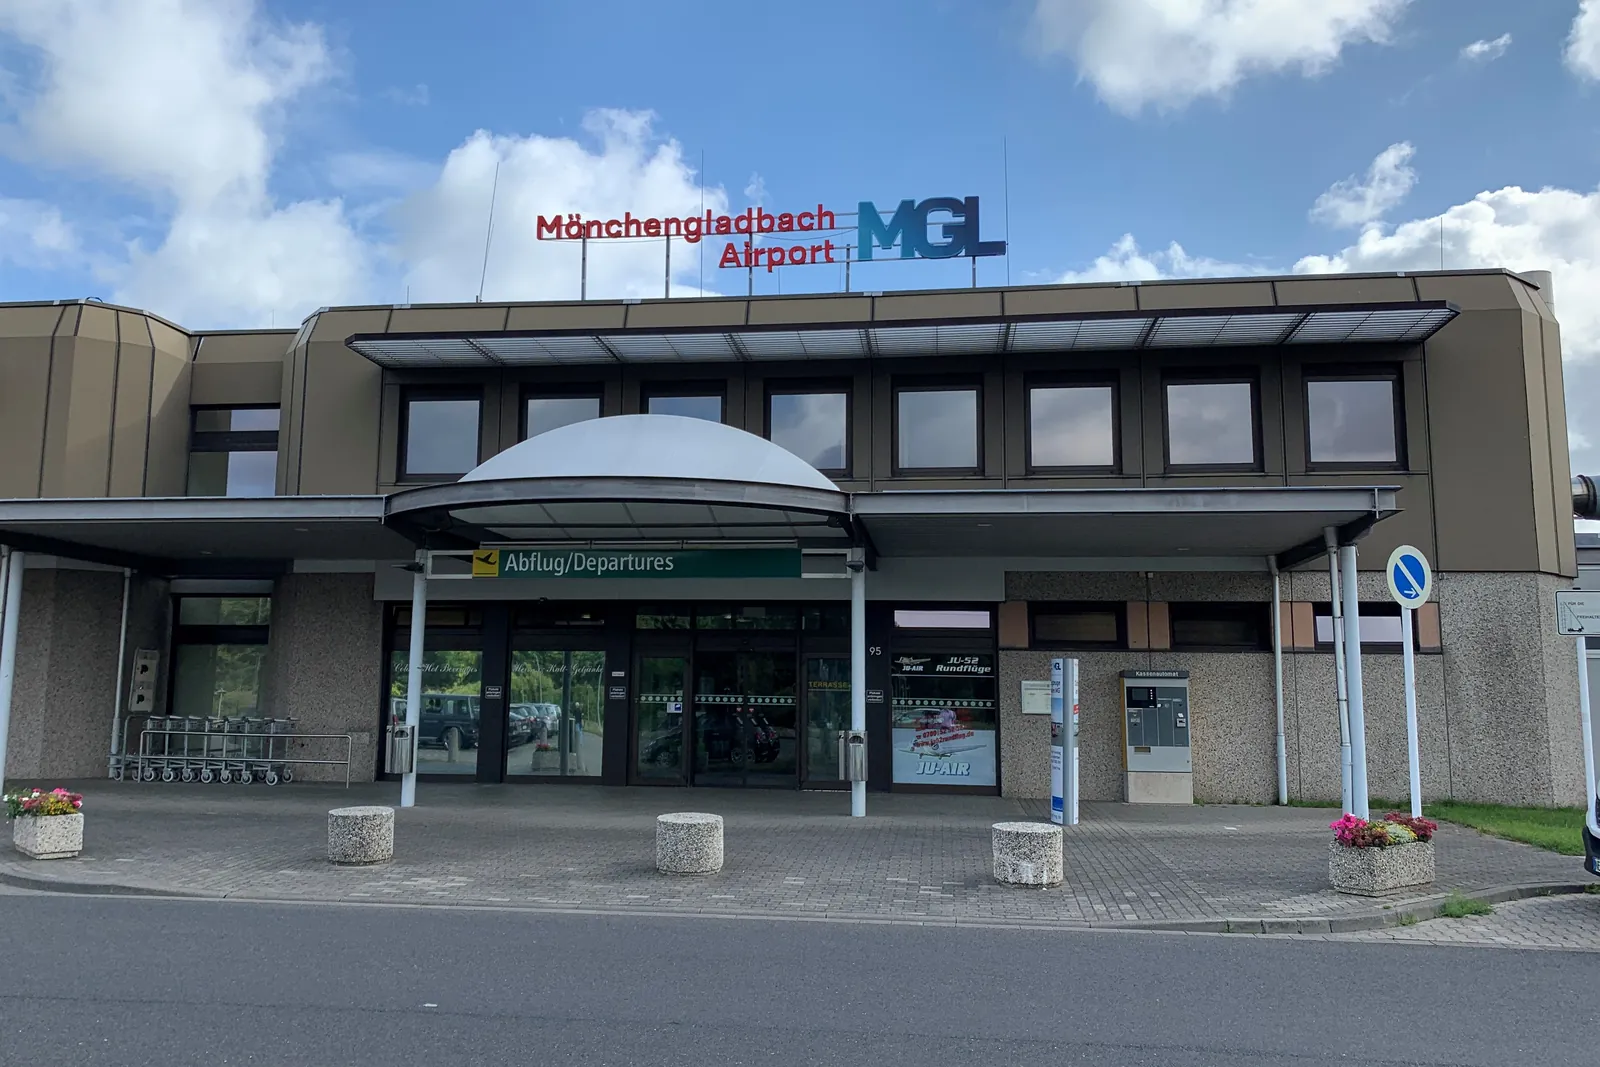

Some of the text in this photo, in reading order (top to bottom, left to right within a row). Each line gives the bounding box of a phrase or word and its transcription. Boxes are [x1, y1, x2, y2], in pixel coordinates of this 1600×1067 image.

[536, 203, 835, 243] Mönchengladbach
[858, 195, 1006, 261] MGL
[719, 239, 834, 273] Airport
[505, 552, 674, 576] Abflug/Departures
[869, 646, 882, 656] 95
[935, 664, 992, 674] Rundflüge
[916, 761, 970, 777] JU-AIR
